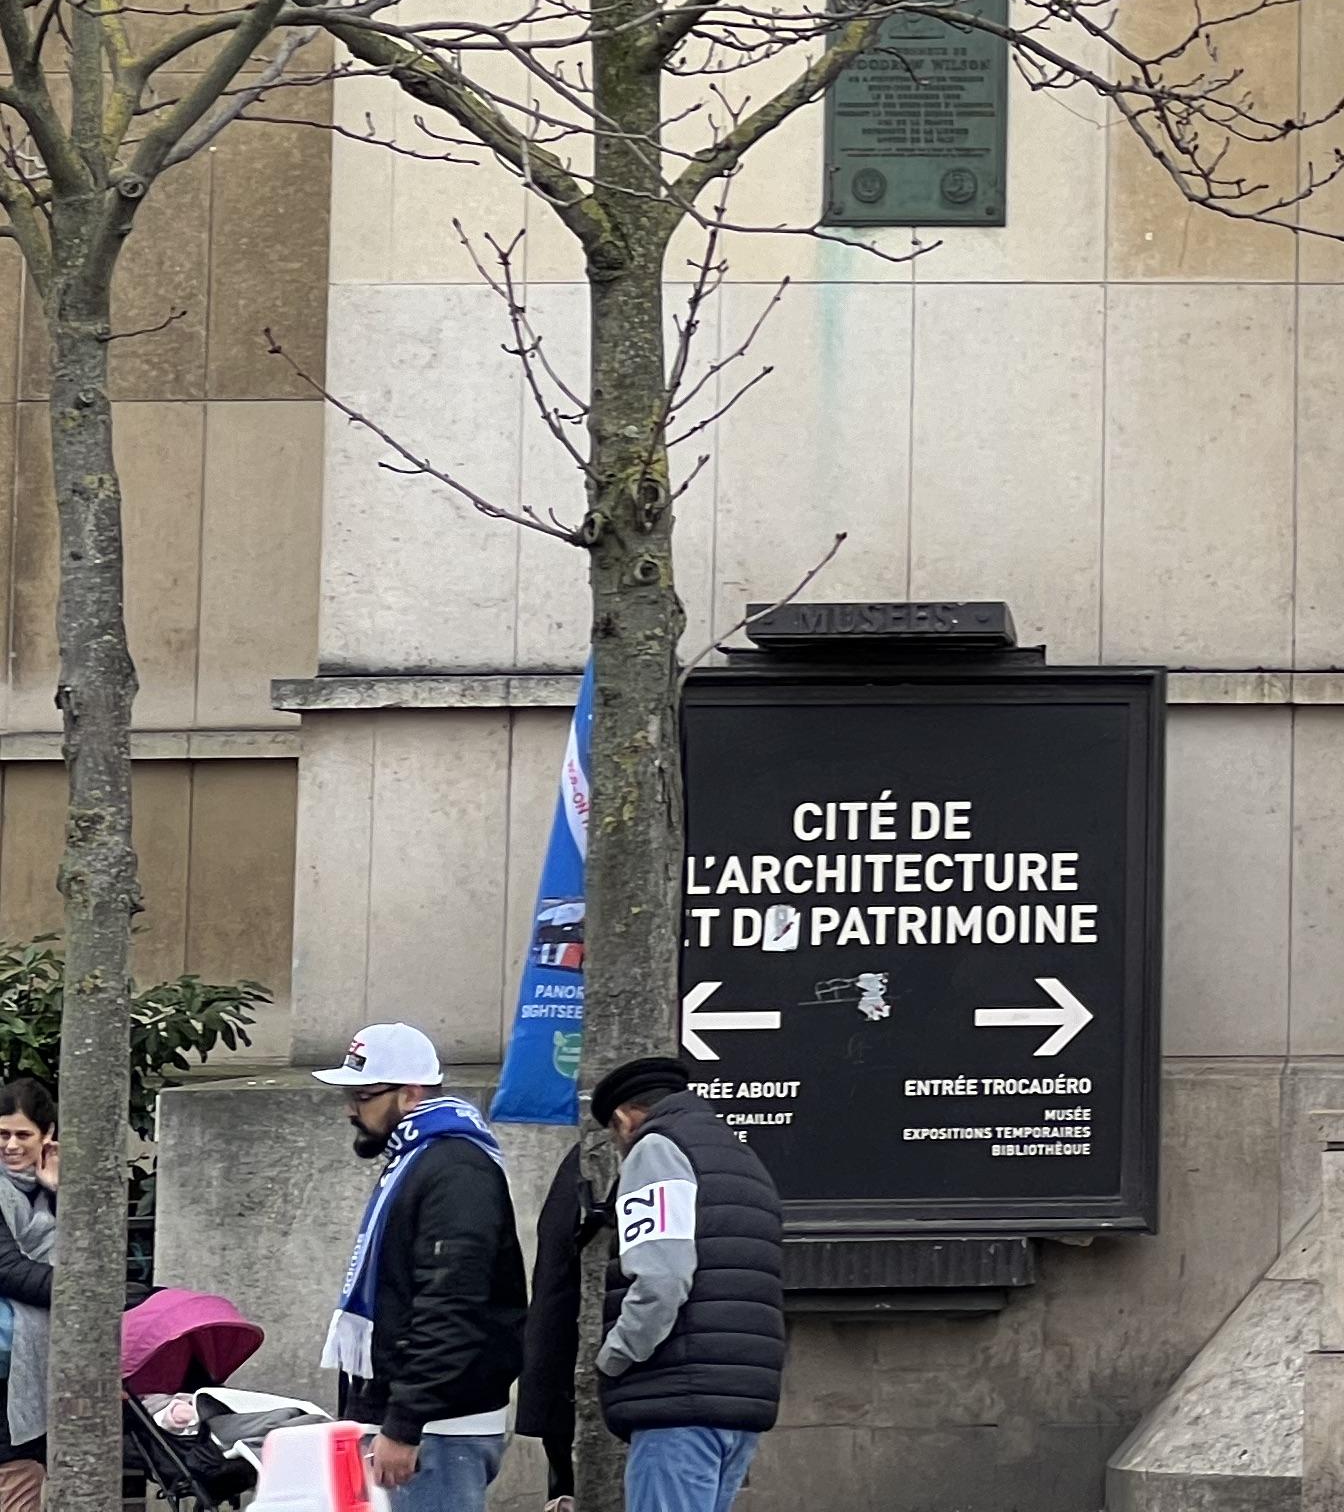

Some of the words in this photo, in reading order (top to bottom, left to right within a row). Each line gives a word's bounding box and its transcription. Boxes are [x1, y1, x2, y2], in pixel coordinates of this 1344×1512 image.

[793, 791, 898, 841] CITÉ
[912, 801, 972, 840] DE
[685, 908, 720, 947] T
[811, 904, 1098, 946] PATRIMOINE
[736, 1081, 801, 1098] ABOUT
[904, 1075, 979, 1096] ENTRÉE
[981, 1074, 1092, 1095] TROCADÉRO
[726, 1112, 793, 1125] CHAILLOT
[1044, 1106, 1092, 1120] MUSÉE
[903, 1127, 993, 1140] EXPOSITIONS
[995, 1126, 1091, 1139] TEMPORAIRES
[991, 1141, 1091, 1156] BIBLIOTHÈQUE
[623, 1188, 656, 1243] 92
